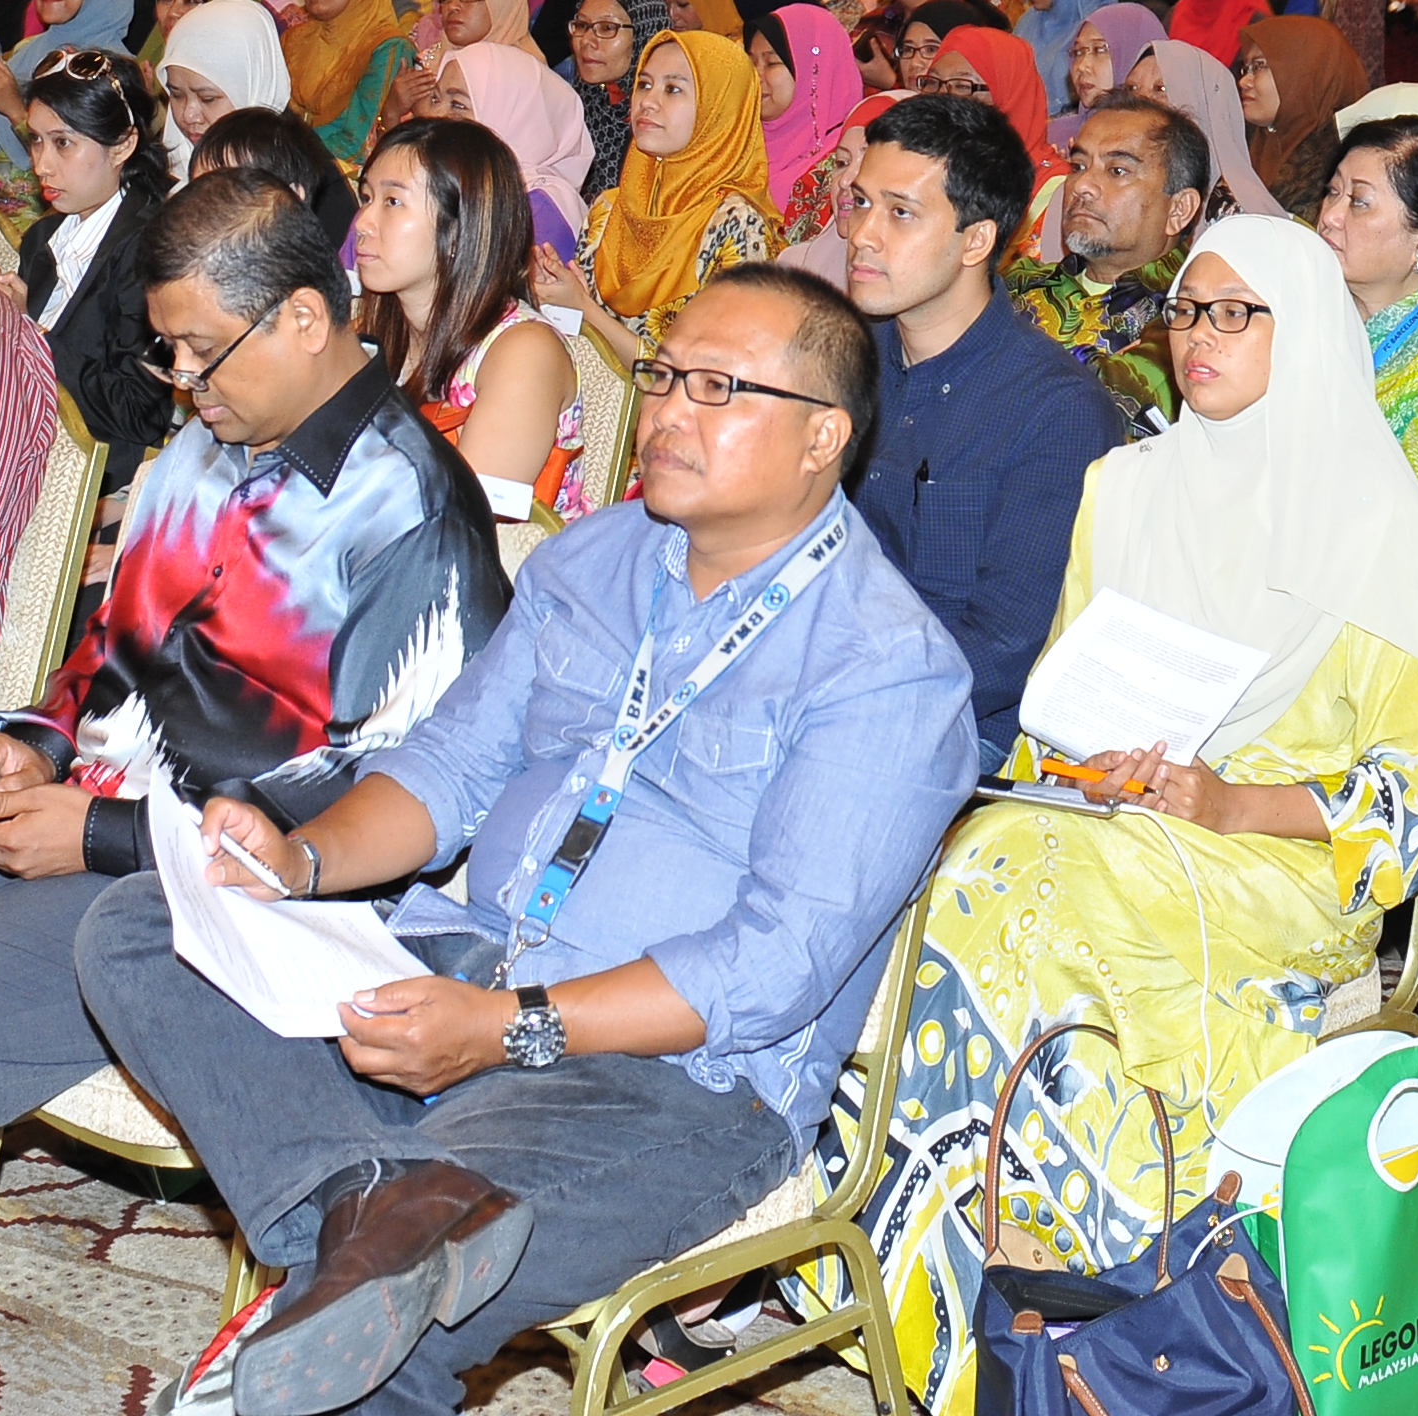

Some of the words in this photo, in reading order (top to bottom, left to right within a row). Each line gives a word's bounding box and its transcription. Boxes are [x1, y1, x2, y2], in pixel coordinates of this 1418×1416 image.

[807, 523, 845, 562] BMW
[719, 611, 764, 656] BMW
[626, 668, 647, 720] BMW
